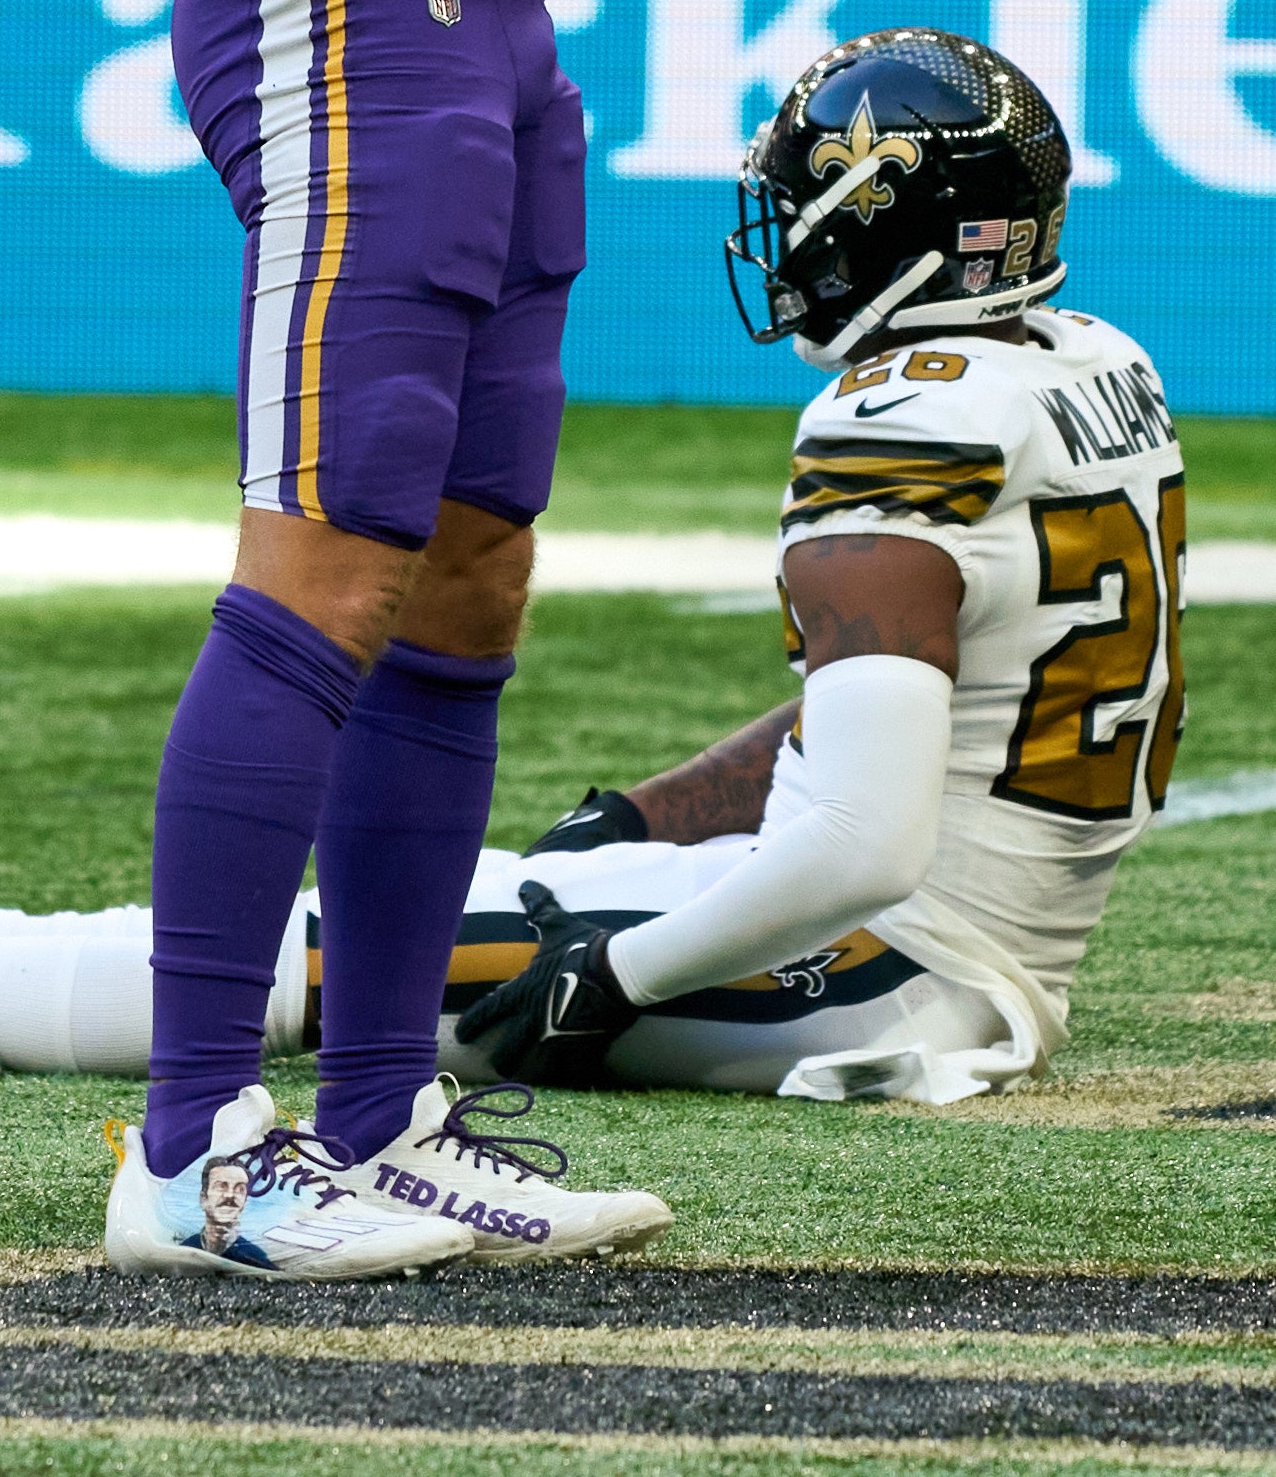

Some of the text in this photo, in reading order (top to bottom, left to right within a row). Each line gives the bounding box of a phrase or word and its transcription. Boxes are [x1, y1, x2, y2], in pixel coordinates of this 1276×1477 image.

[1002, 203, 1065, 276] 26
[373, 1162, 551, 1245] TED LASSO
